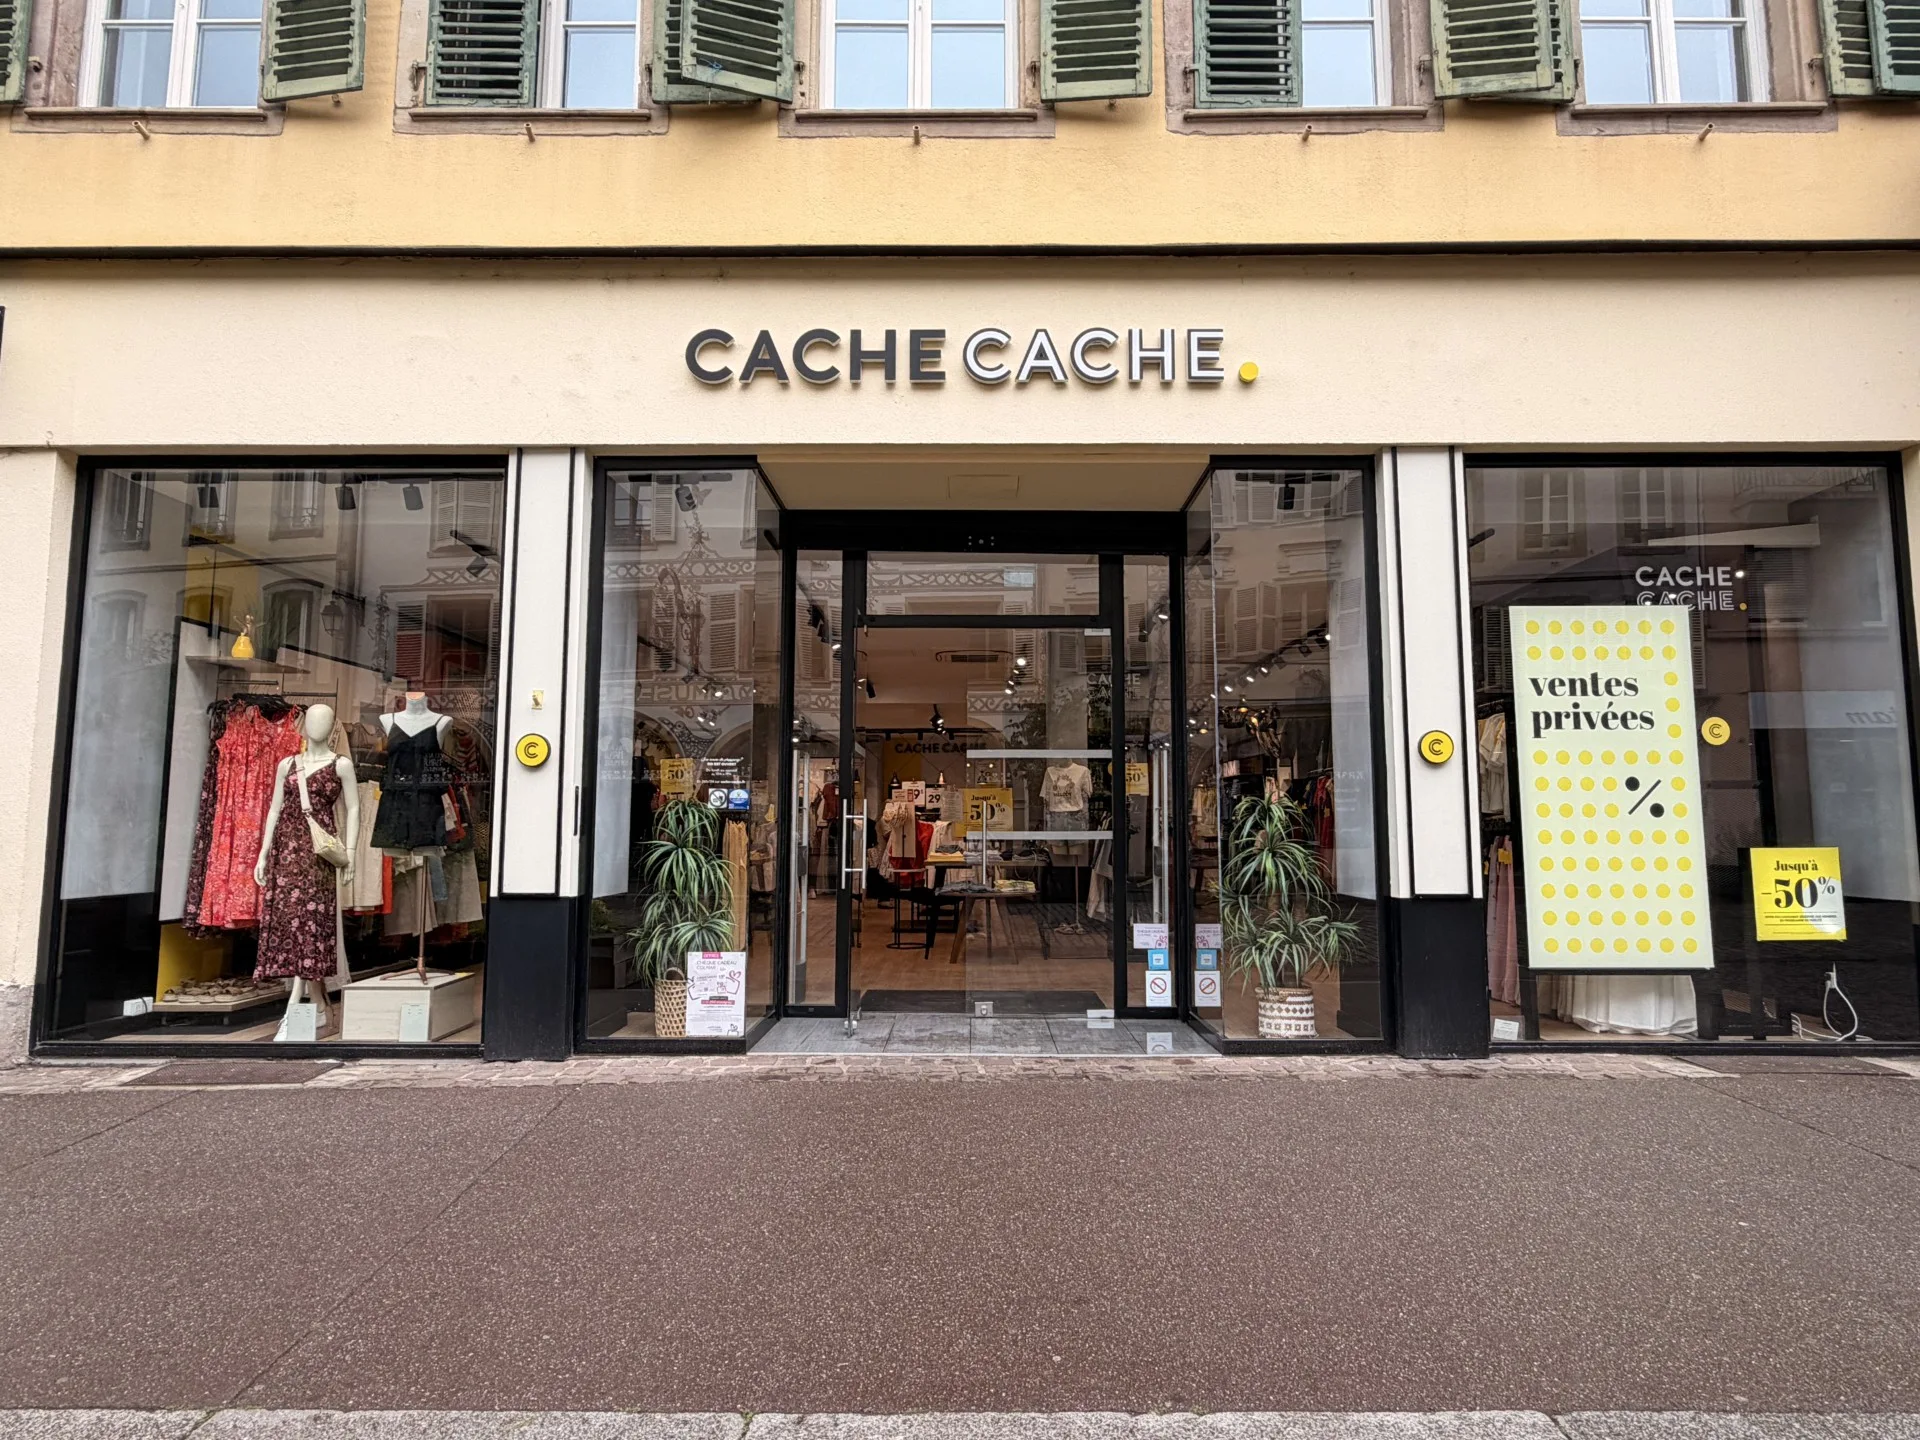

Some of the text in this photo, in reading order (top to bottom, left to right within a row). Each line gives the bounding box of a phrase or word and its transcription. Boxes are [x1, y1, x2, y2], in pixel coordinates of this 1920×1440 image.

[685, 328, 946, 384] CACHE
[1635, 566, 1733, 587] CACHE
[1528, 672, 1639, 697] ventes
[1530, 701, 1655, 739] privées
[523, 741, 539, 759] C
[894, 743, 940, 754] CACHE
[1428, 738, 1444, 756] C
[1774, 859, 1819, 874] Jusqu'à
